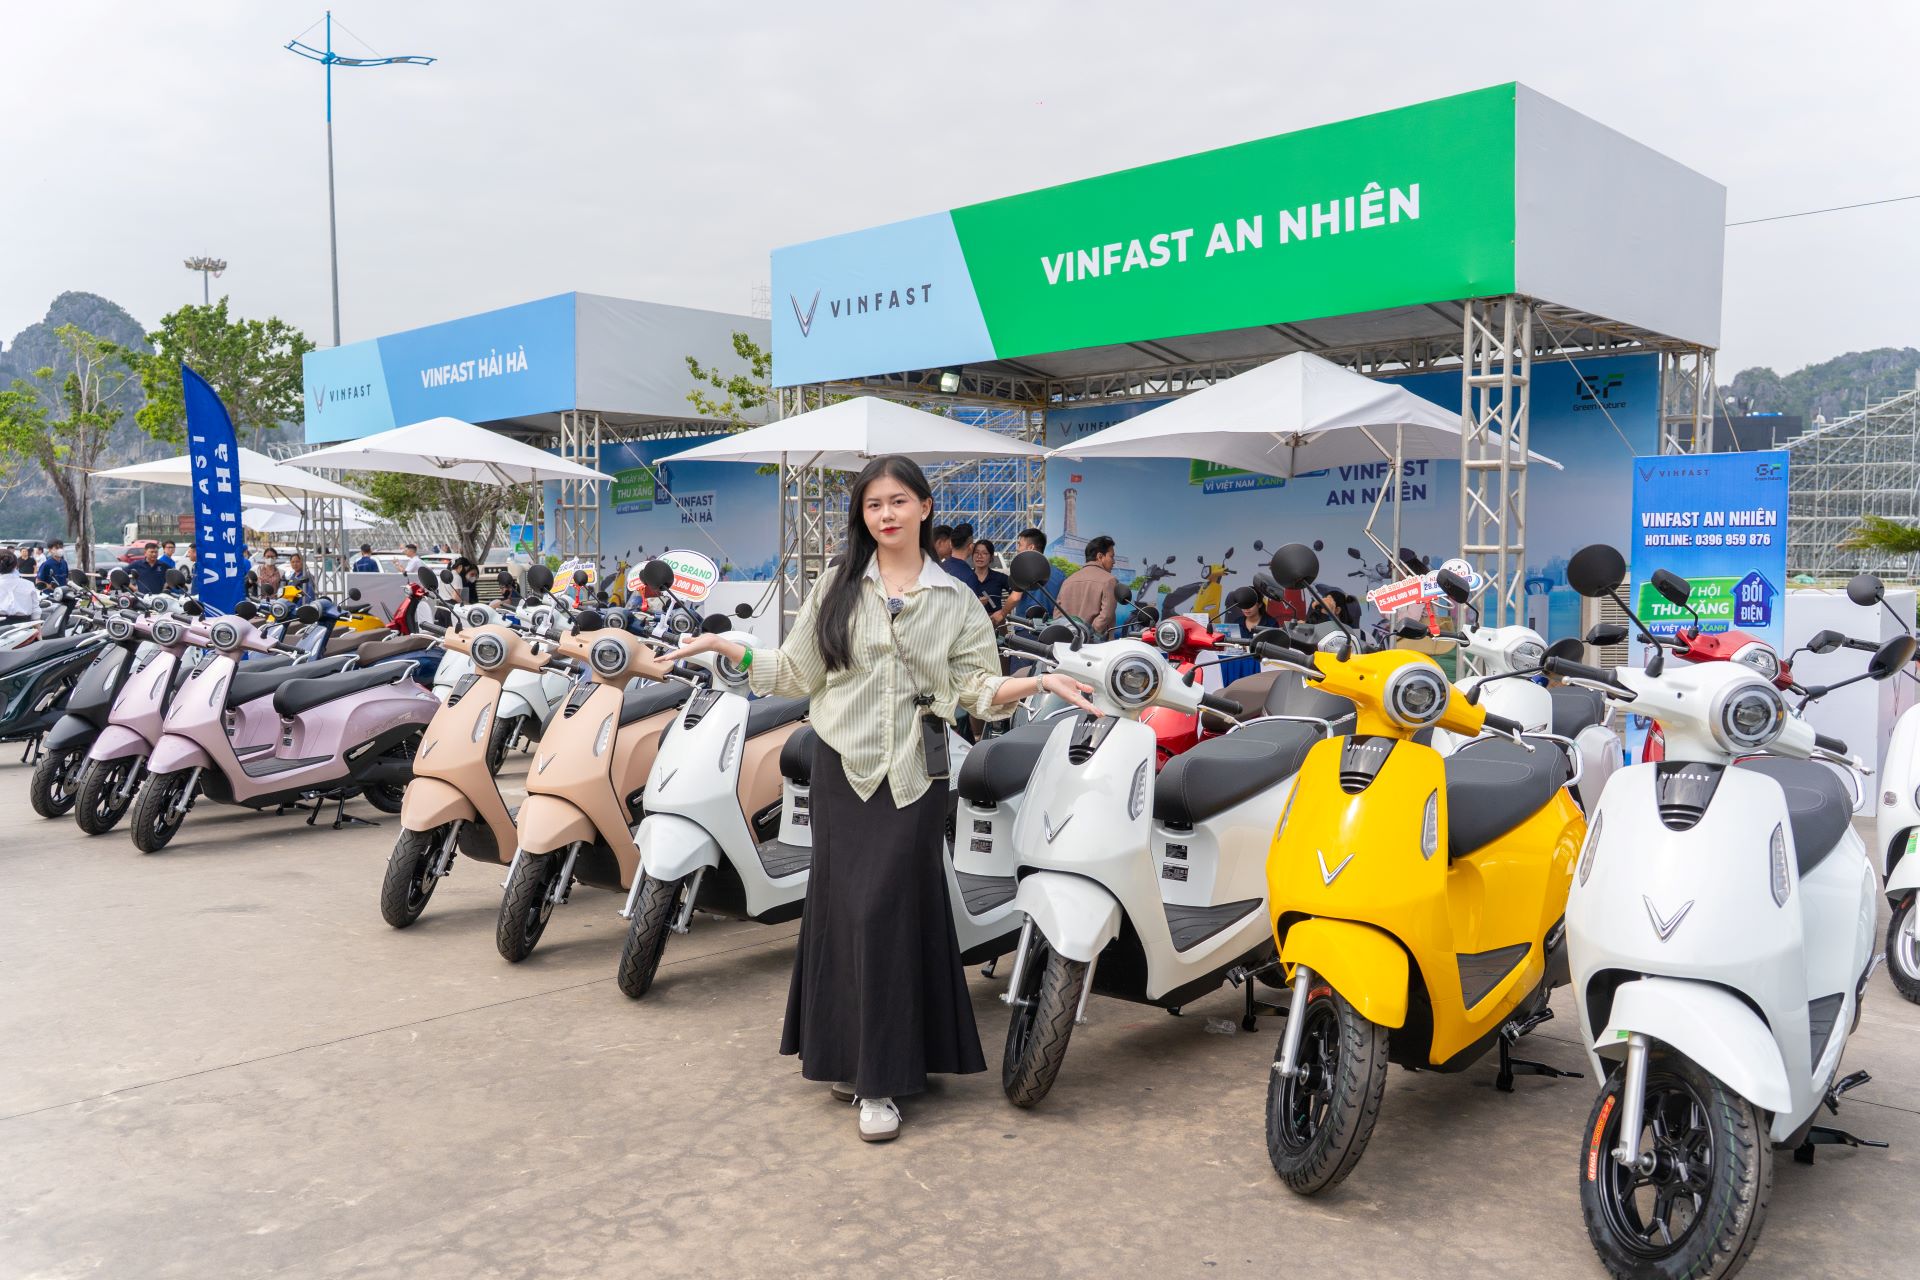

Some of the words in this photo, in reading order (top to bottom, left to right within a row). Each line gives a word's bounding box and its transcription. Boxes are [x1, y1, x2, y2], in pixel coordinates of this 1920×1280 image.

[1040, 228, 1194, 285] VINFAST
[1205, 214, 1263, 258] AN
[1279, 181, 1420, 244] NHIÊN
[830, 283, 932, 318] VINFAST
[421, 360, 475, 389] VINFAST
[478, 348, 502, 379] HẢI
[507, 345, 528, 373] HÀ
[330, 384, 372, 402] VINFAST
[214, 442, 232, 493] Hà
[1339, 459, 1429, 481] VINFST
[1659, 469, 1710, 478] VINFAST
[1205, 480, 1214, 491] VÌ
[1216, 480, 1234, 491] VIỆT
[1235, 479, 1255, 489] NAM
[675, 494, 714, 508] VINFAST
[1326, 489, 1355, 506] AN
[699, 508, 713, 523] HÀ
[1642, 512, 1700, 528] VINFAST
[1703, 511, 1725, 527] AN
[1729, 507, 1777, 527] NHIÊN
[220, 512, 238, 578] Hải
[1645, 534, 1693, 546] HOTLINE:
[1695, 533, 1722, 546] 0396
[1725, 533, 1747, 546] 959
[1749, 533, 1771, 546] 876
[678, 563, 713, 580] GRAND
[1698, 583, 1721, 599] HỘI
[1742, 577, 1763, 602] ĐỔI
[1685, 600, 1730, 615] XĂNG
[1741, 605, 1763, 622] ĐIỆN
[1651, 624, 1660, 632] VÌ
[1661, 624, 1679, 634] VIỆT
[1701, 623, 1727, 632] XANH
[1347, 744, 1384, 753] VINFAST
[1662, 773, 1710, 782] VINFAST
[1588, 1151, 1598, 1180] KENDA
